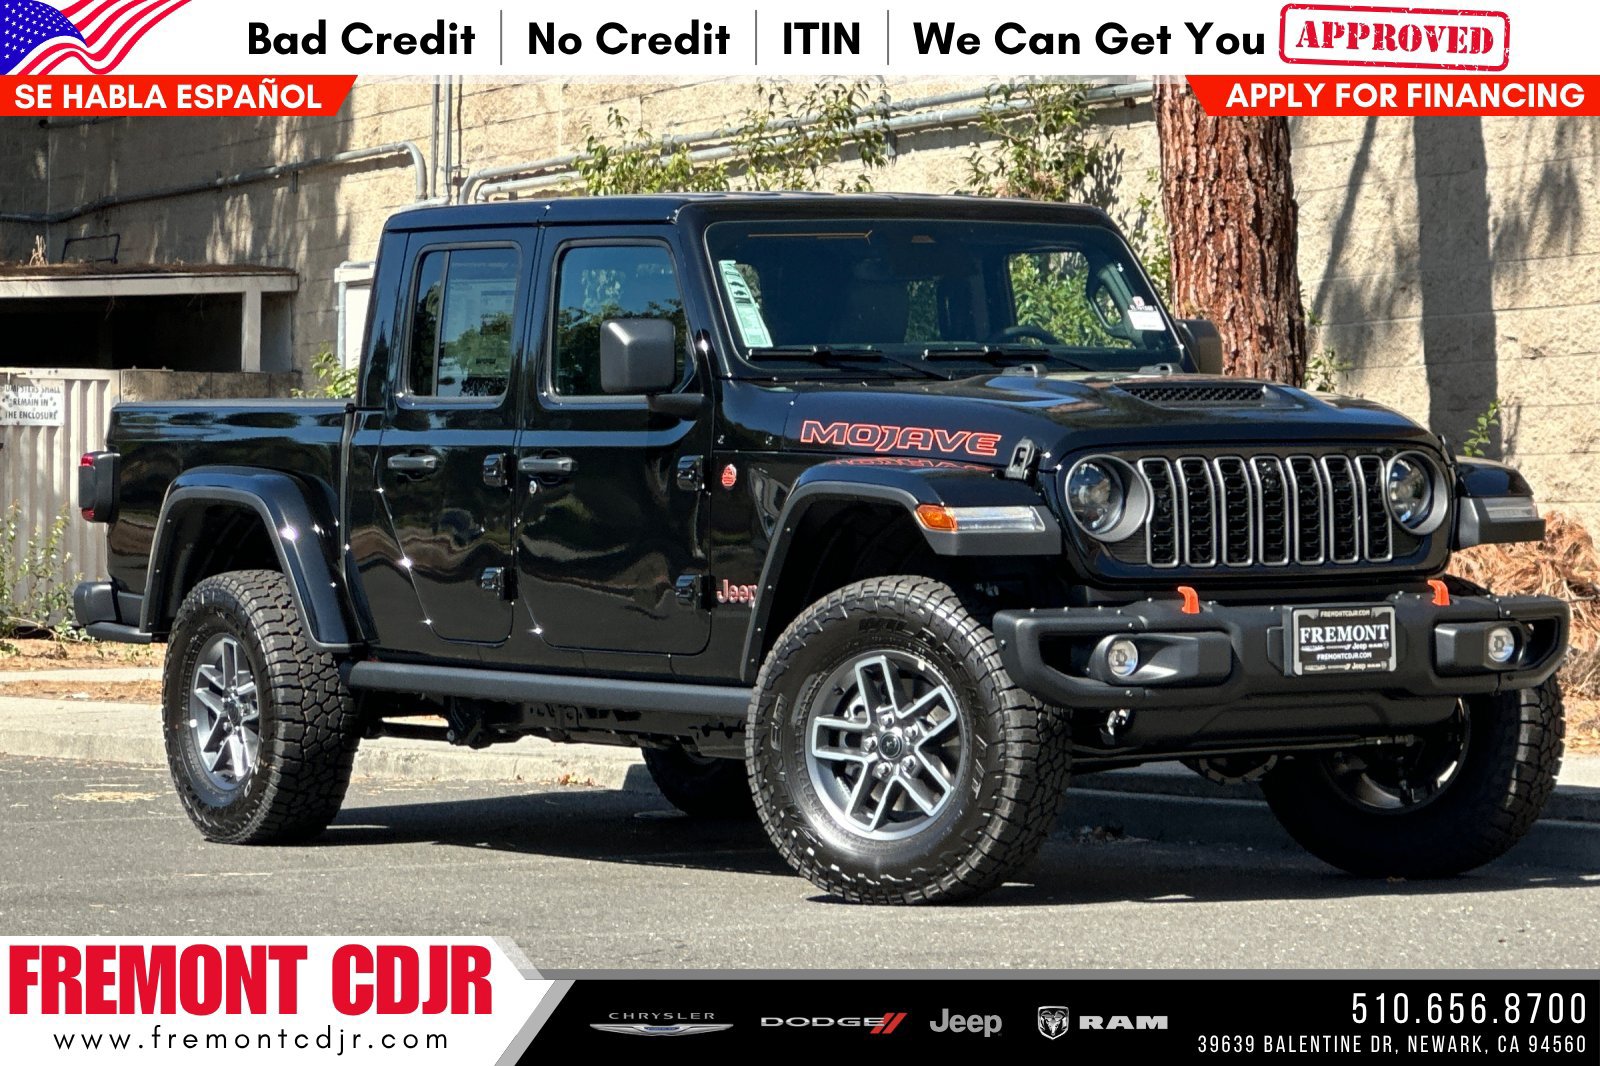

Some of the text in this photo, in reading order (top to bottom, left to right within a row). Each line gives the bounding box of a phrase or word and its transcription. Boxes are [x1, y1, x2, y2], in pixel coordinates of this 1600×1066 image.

[40, 398, 49, 406] IN
[19, 411, 57, 420] ENCLOSURE
[800, 420, 1001, 457] MOJAVE
[1320, 609, 1370, 618] FREMONTCDJR.COM
[1299, 624, 1389, 643] FREMONT
[1316, 651, 1372, 661] FREMONTCDJR.COM
